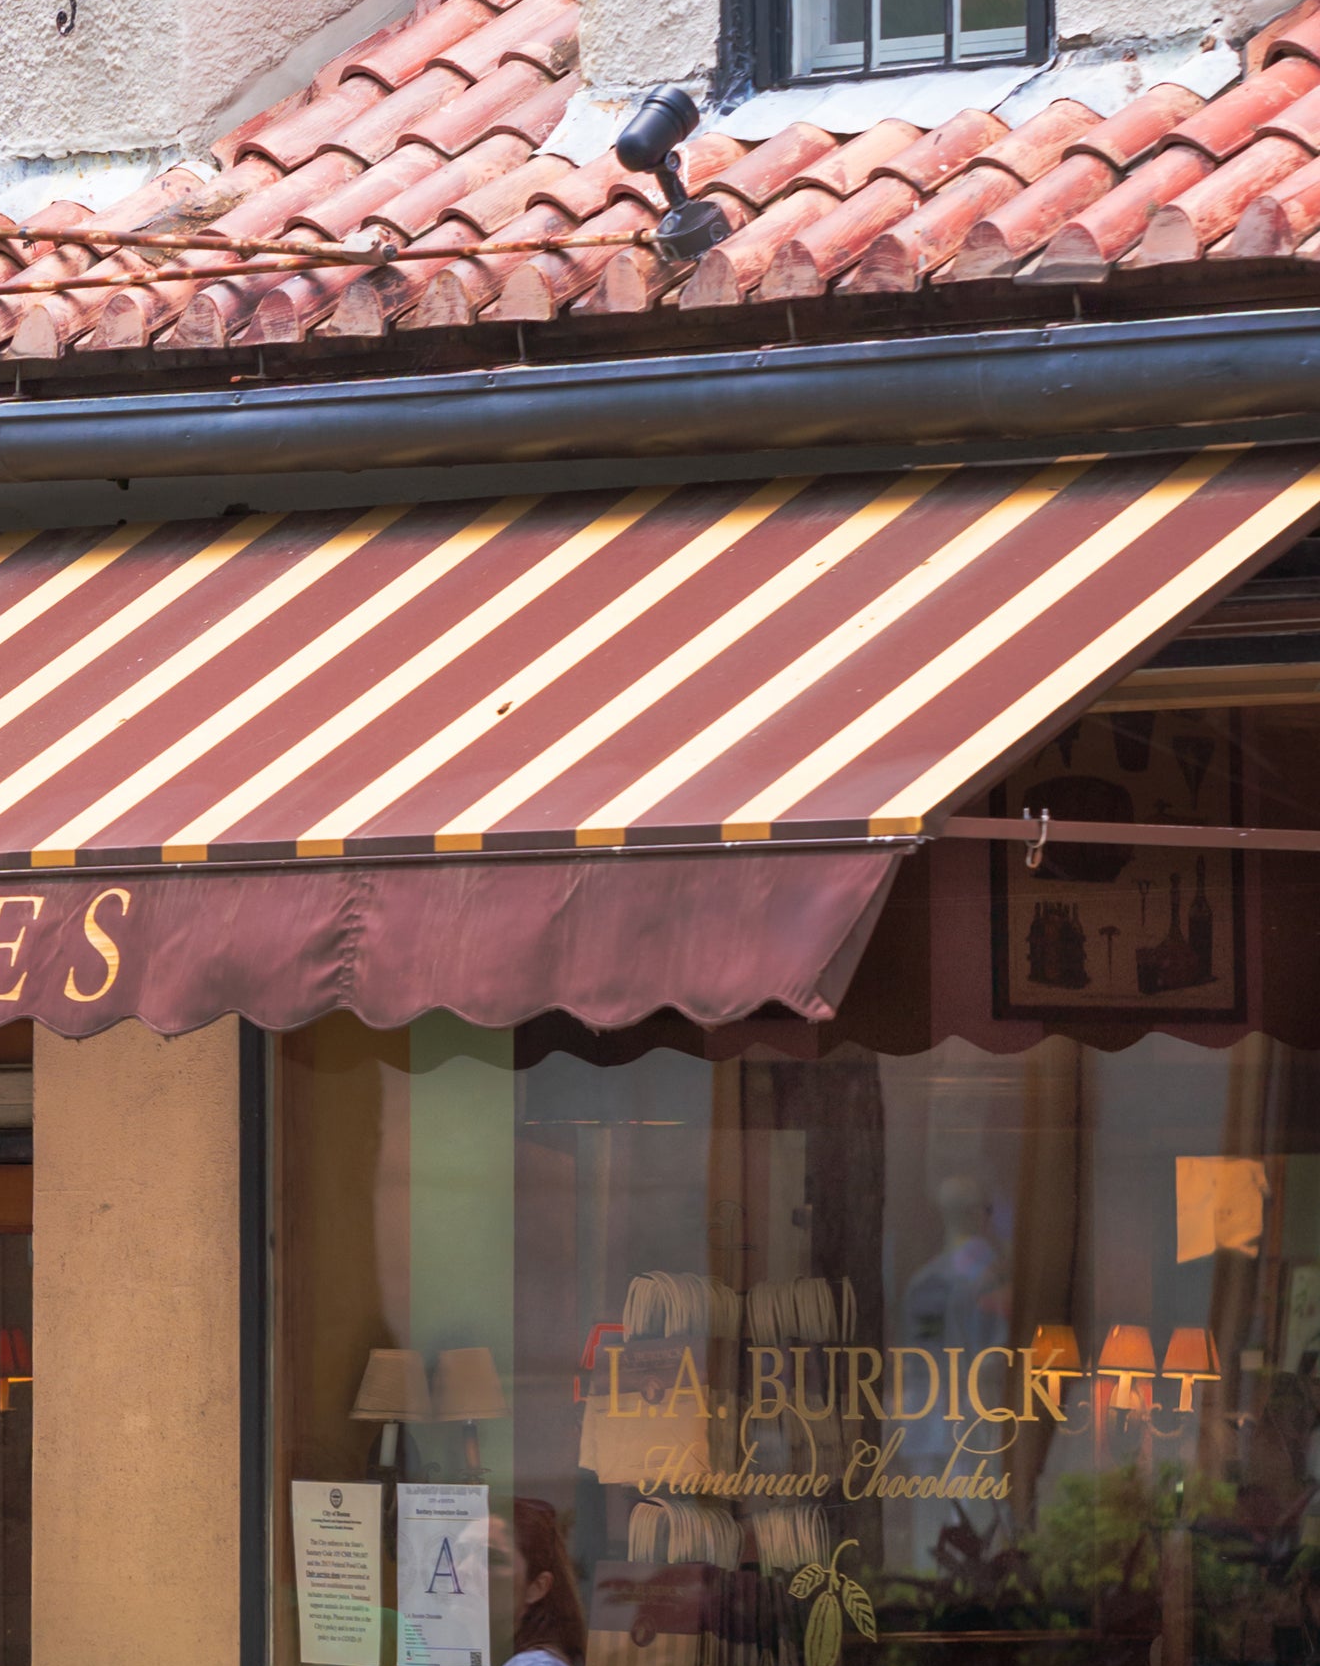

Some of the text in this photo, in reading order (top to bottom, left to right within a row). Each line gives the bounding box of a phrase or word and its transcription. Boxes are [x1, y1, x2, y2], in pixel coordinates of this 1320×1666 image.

[603, 1345, 1068, 1423] L.A. BURDICK
[638, 1418, 1016, 1501] Handmade Chocolates
[425, 1536, 465, 1594] A
